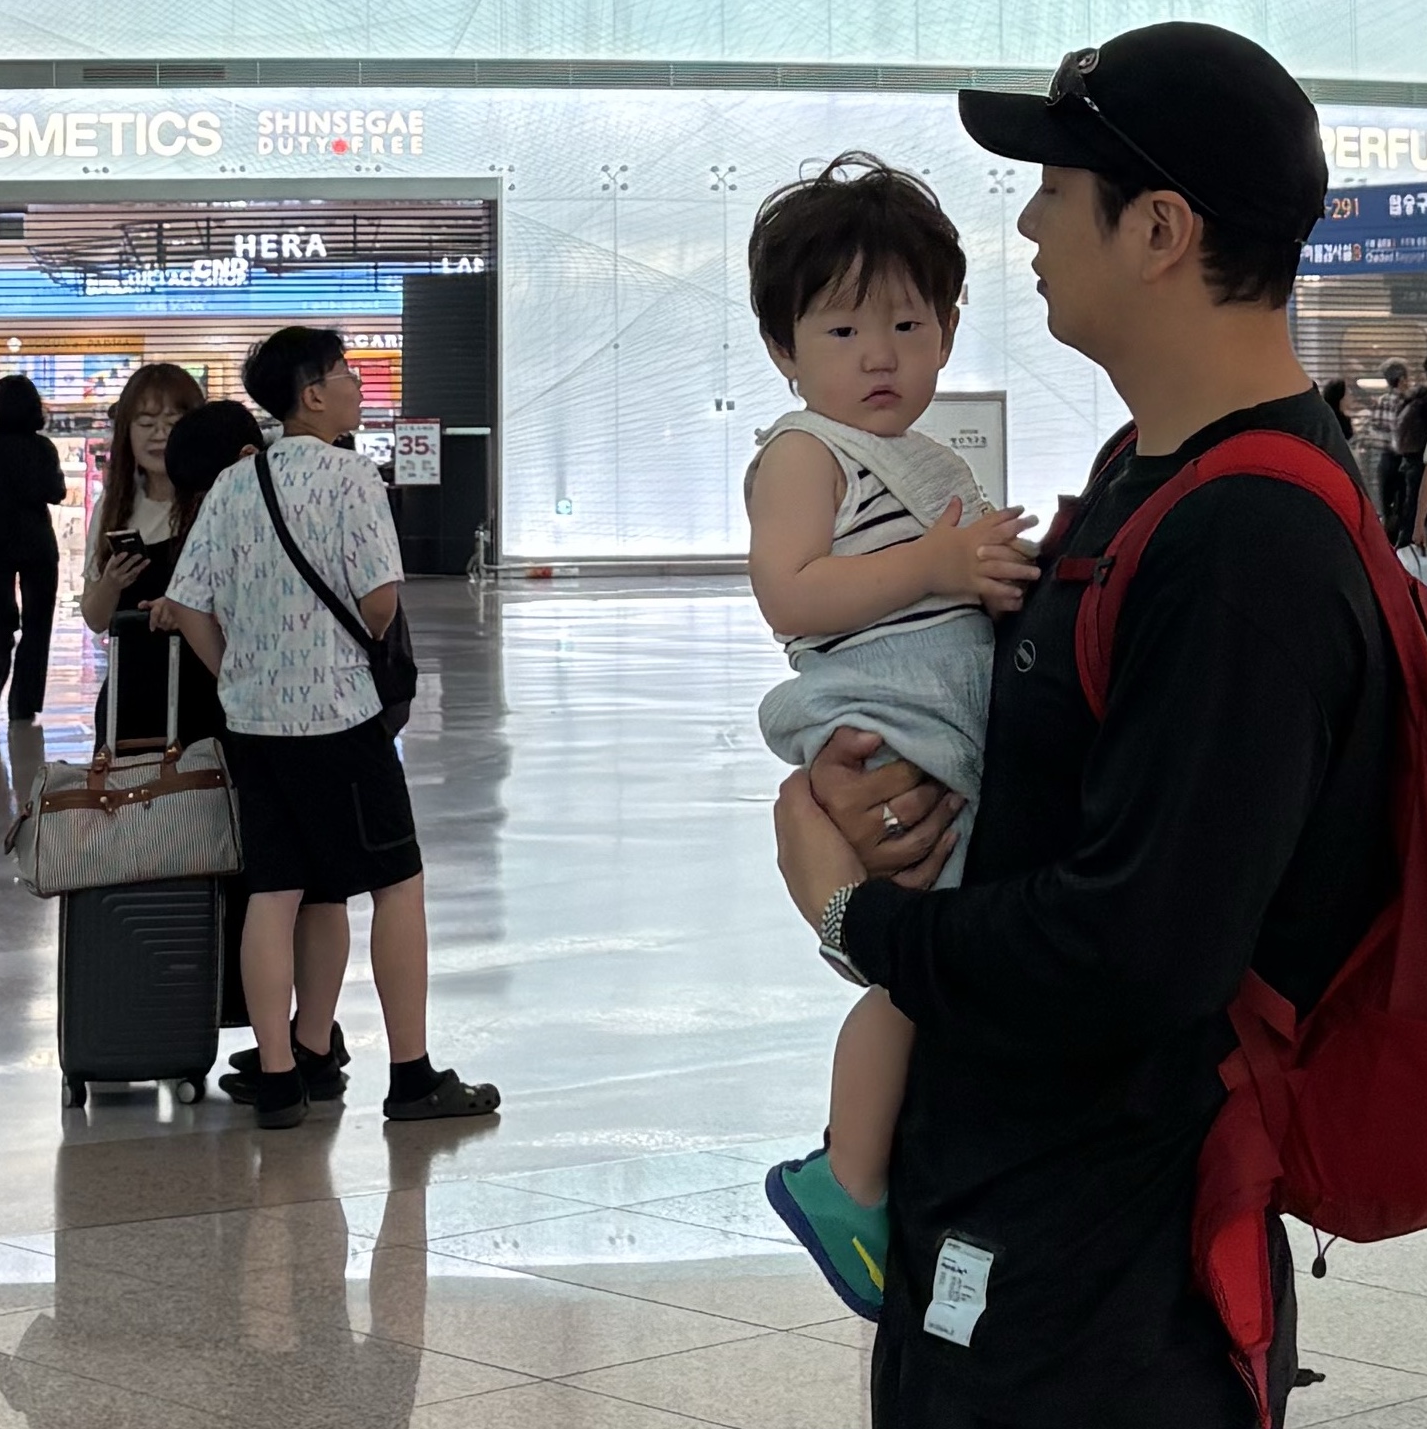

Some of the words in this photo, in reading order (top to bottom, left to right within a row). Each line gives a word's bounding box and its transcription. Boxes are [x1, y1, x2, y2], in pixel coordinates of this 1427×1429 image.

[257, 109, 424, 135] SHINSEGAE
[257, 136, 330, 155] DUTY
[351, 136, 424, 155] FREE
[234, 233, 328, 259] HERA
[283, 471, 314, 487] NY
[281, 613, 312, 632] NY
[254, 634, 281, 651] NY
[281, 649, 312, 668] NY
[281, 685, 312, 704] NY
